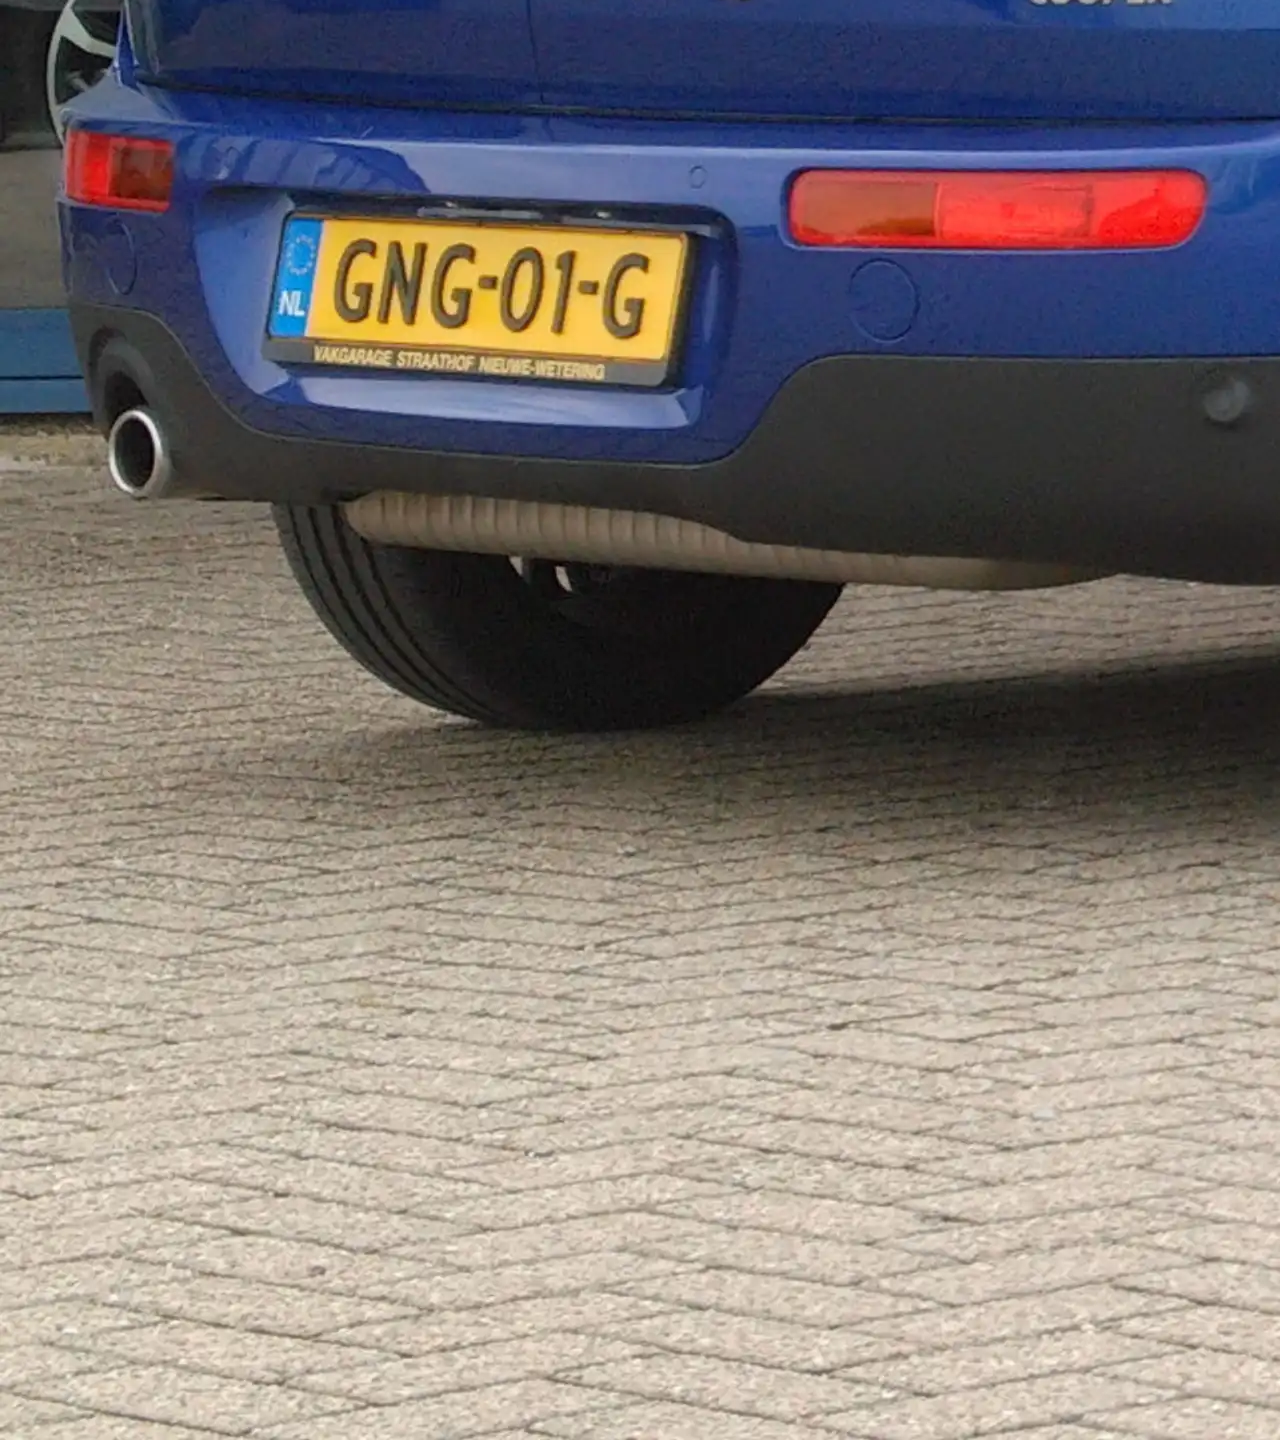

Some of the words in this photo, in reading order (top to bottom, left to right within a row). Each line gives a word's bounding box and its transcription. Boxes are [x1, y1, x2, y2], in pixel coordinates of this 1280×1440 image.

[278, 290, 305, 316] NL
[334, 239, 650, 339] GNG-01-G
[313, 345, 392, 367] VAKGARAGE
[396, 350, 474, 372] STRAATHOF
[478, 357, 605, 380] NIEUWE-WETERING
